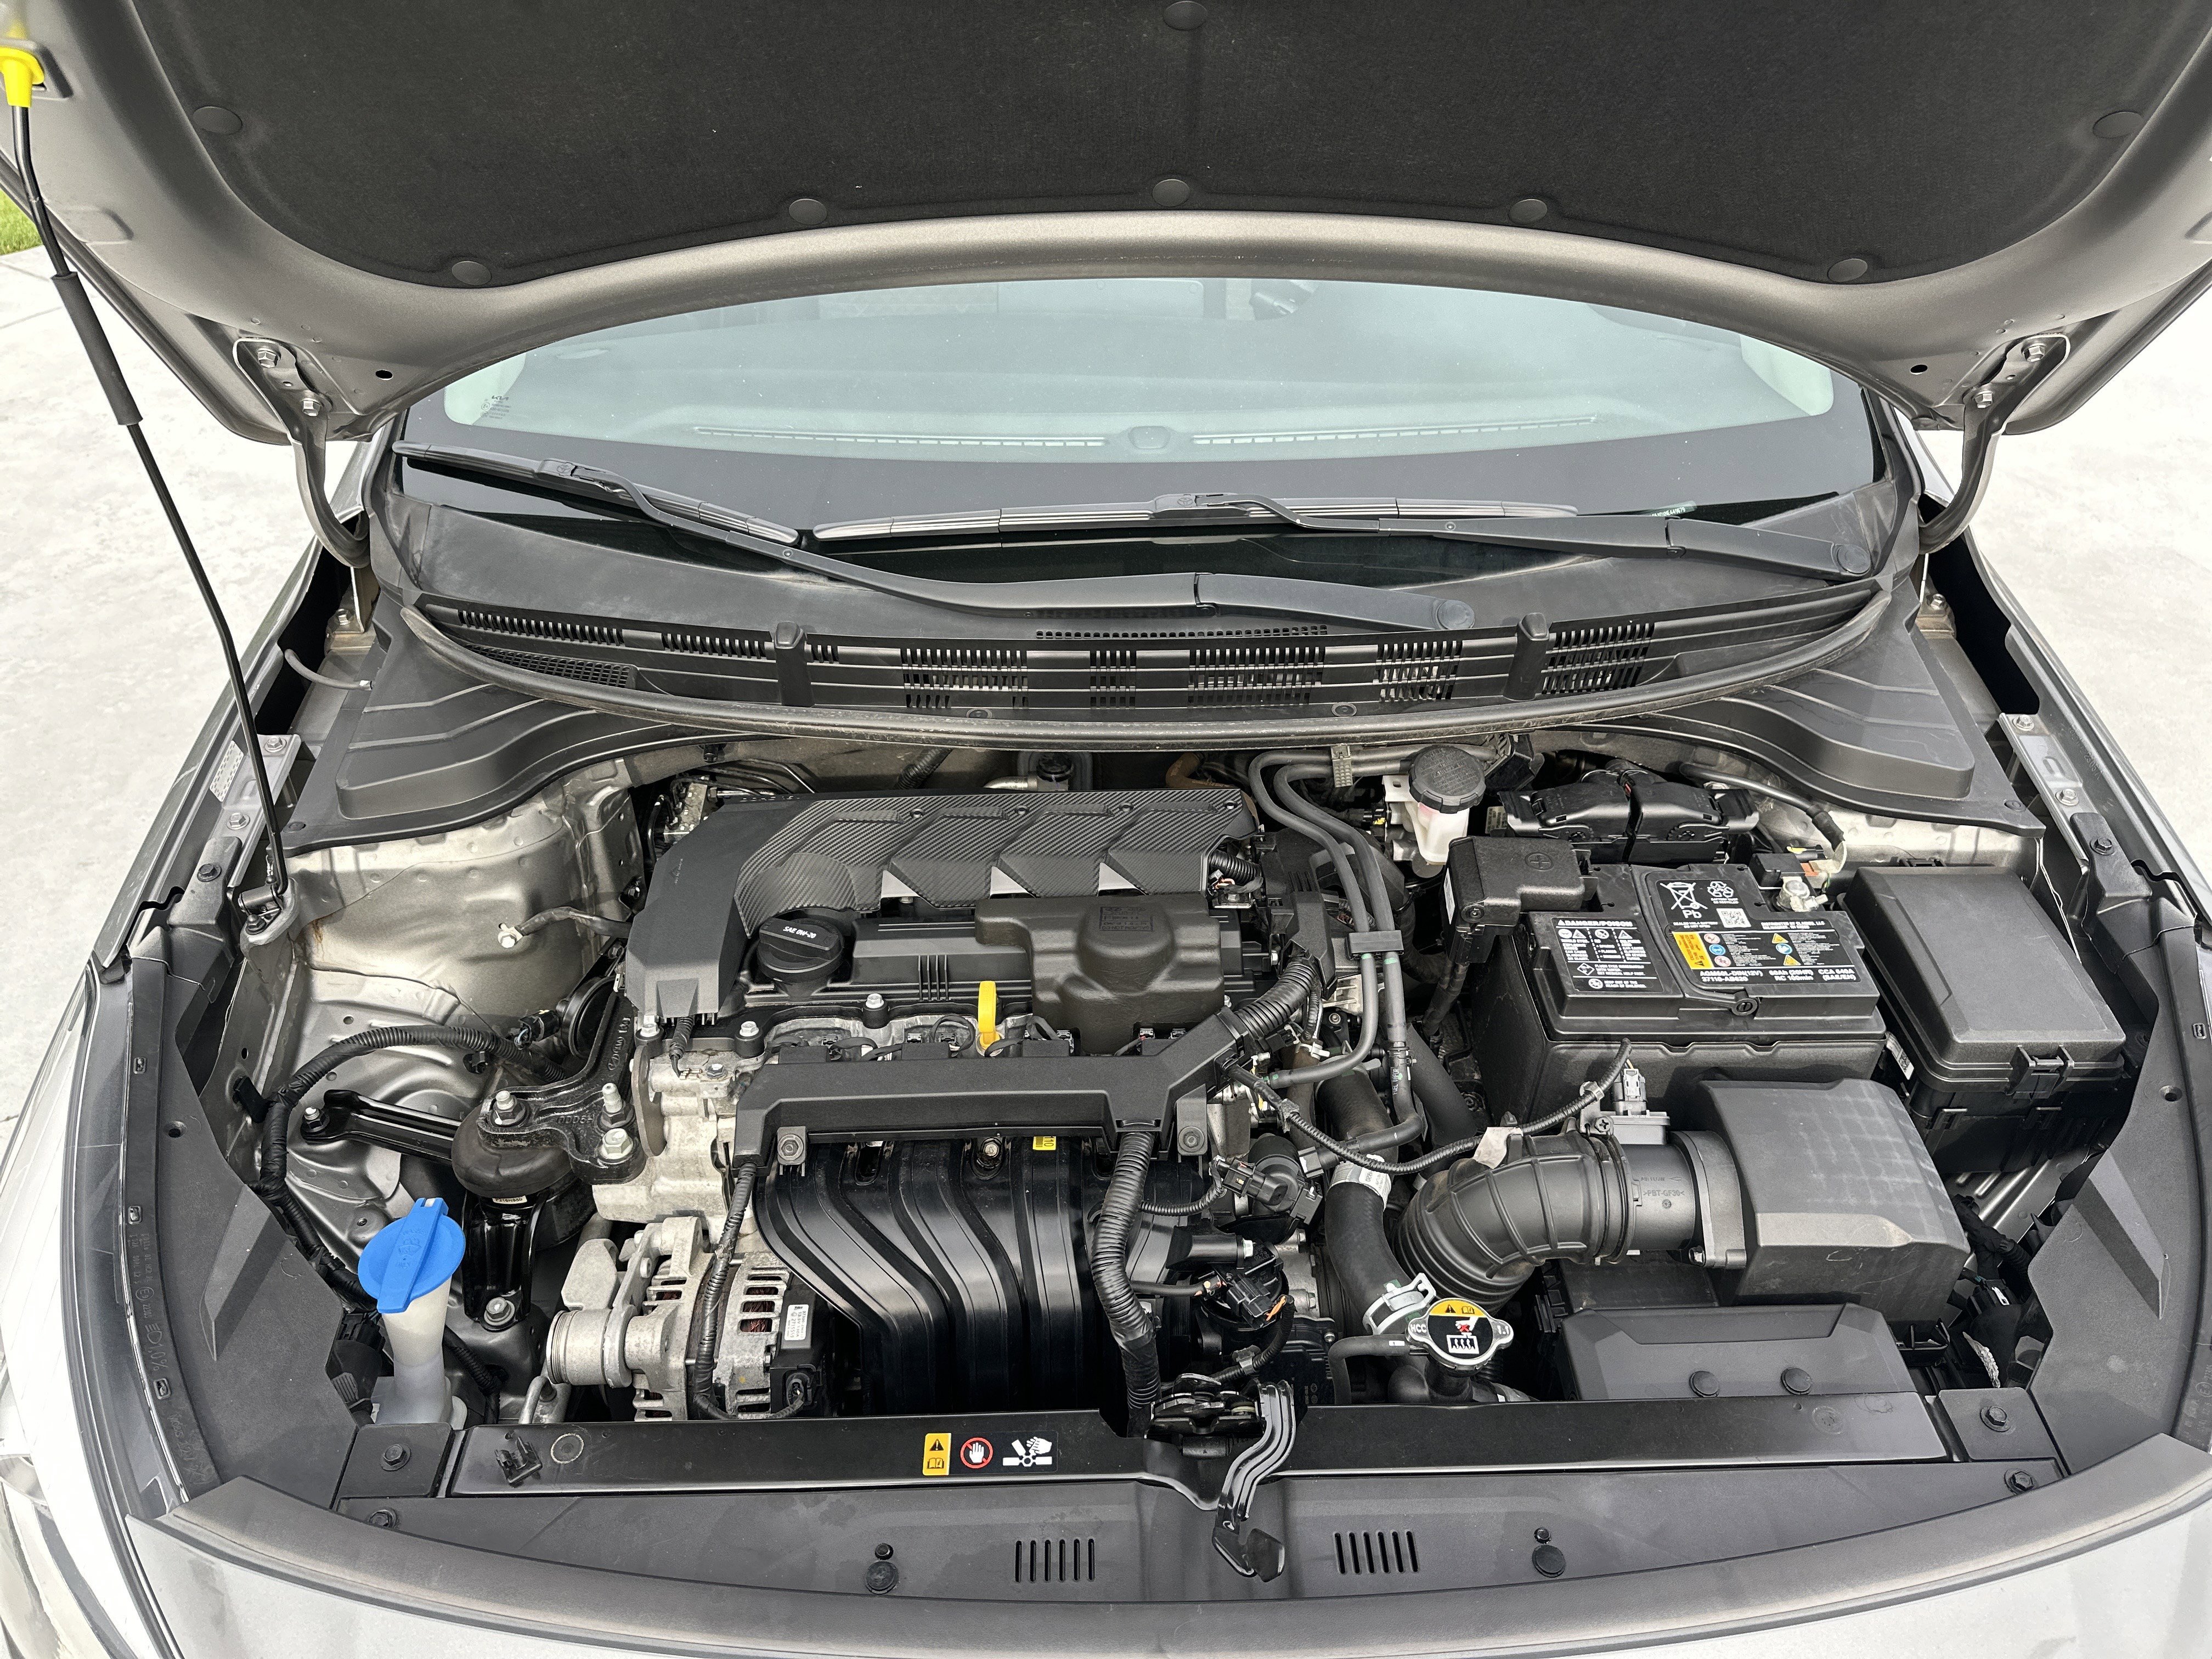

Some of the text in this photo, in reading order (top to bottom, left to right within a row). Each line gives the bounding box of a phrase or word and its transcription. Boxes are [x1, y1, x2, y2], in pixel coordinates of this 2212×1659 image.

[1682, 910, 1702, 918] Pb
[796, 929, 816, 938] 0W-20
[1410, 1324, 1509, 1335] HCC 1.1
